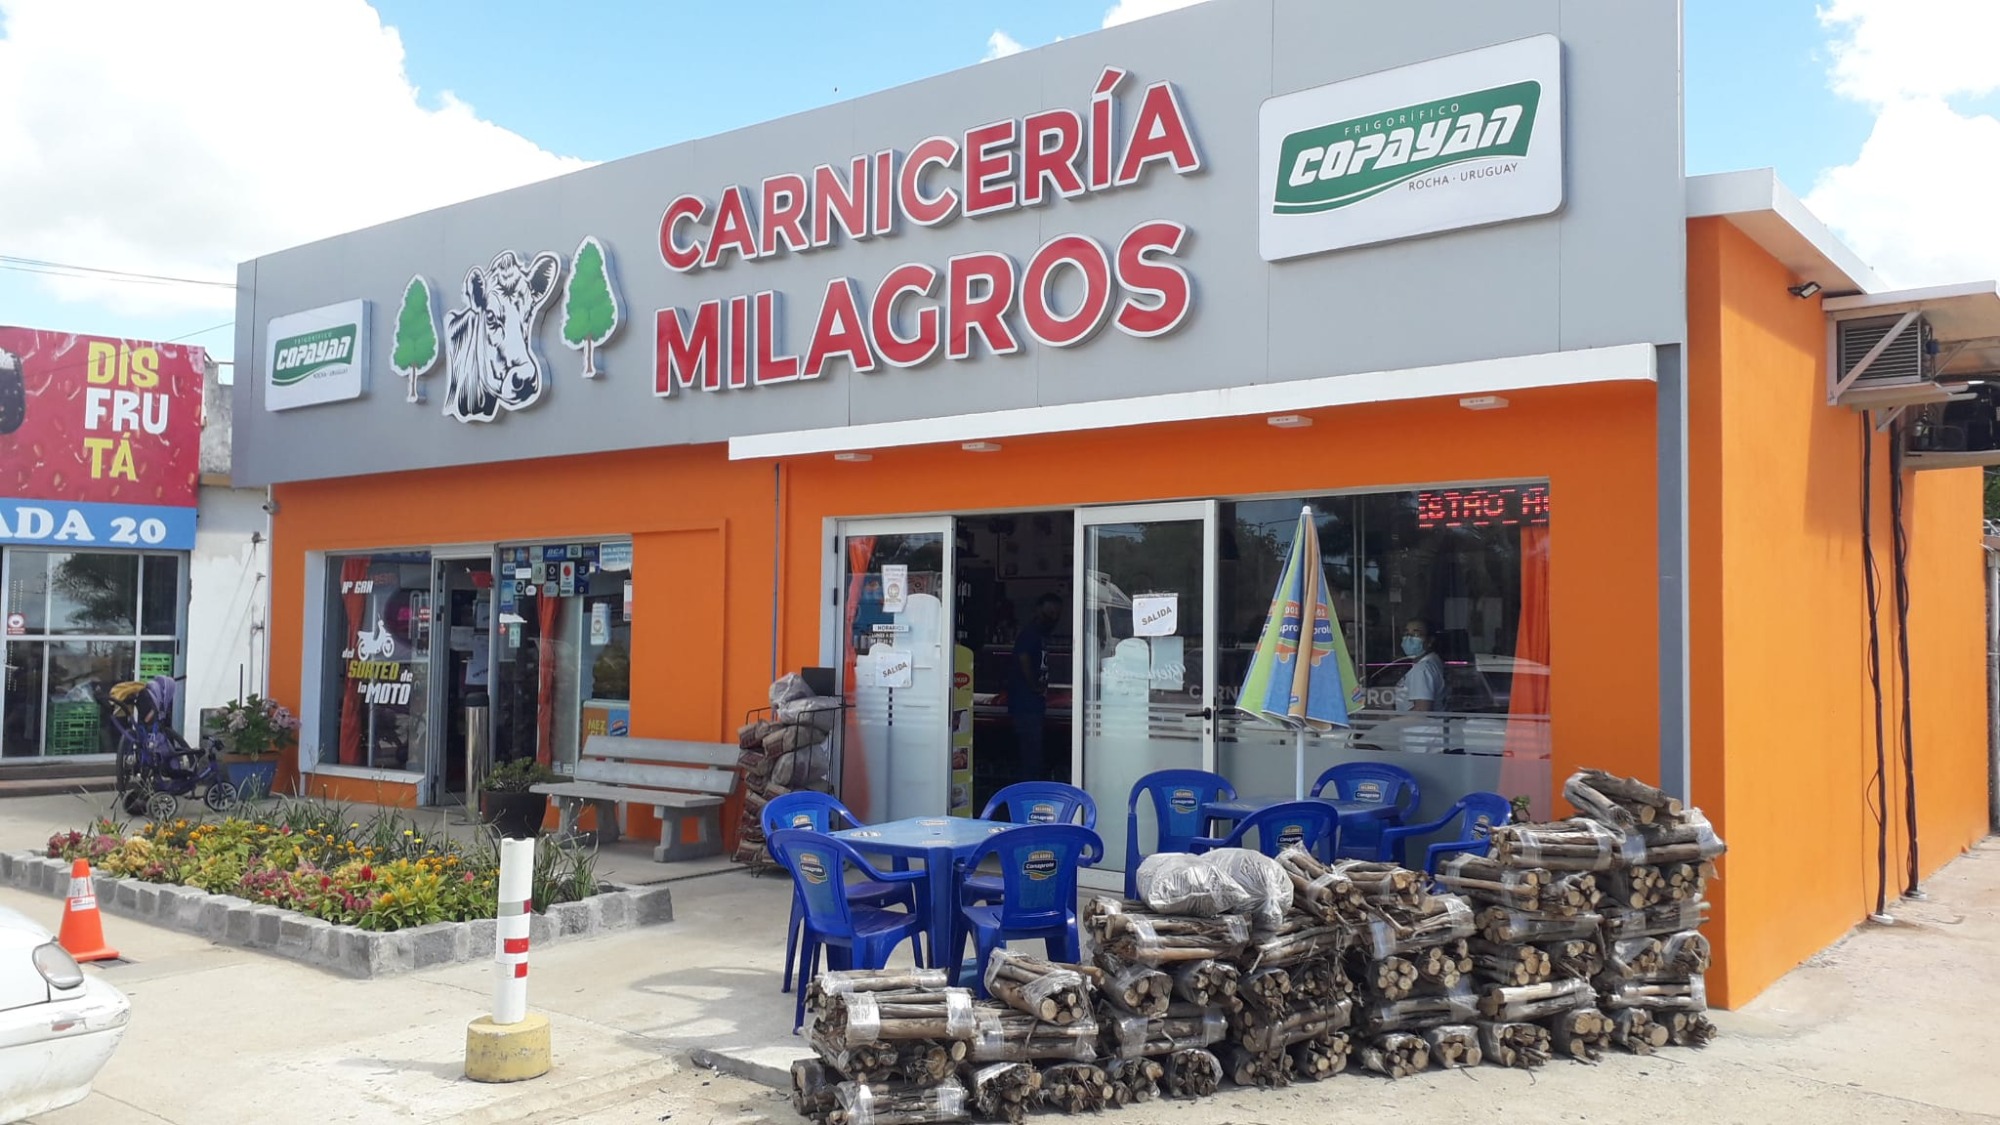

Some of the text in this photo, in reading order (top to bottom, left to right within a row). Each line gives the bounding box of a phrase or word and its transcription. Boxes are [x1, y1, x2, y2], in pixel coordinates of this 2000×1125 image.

[1345, 102, 1460, 137] FRIGORÍFICO
[658, 65, 1201, 273] CARNICERÍA
[1408, 162, 1519, 192] ROCHA URUGUAY
[653, 218, 1191, 399] MILAGROS
[87, 341, 160, 388] DIS
[84, 387, 169, 434] FRU
[83, 432, 138, 481] TÁ
[109, 516, 167, 544] 20
[1140, 605, 1173, 627] SALIDA
[347, 660, 400, 680] SORTEO
[400, 669, 414, 682] de
[882, 661, 908, 679] SALIDA
[365, 682, 411, 705] MOTO
